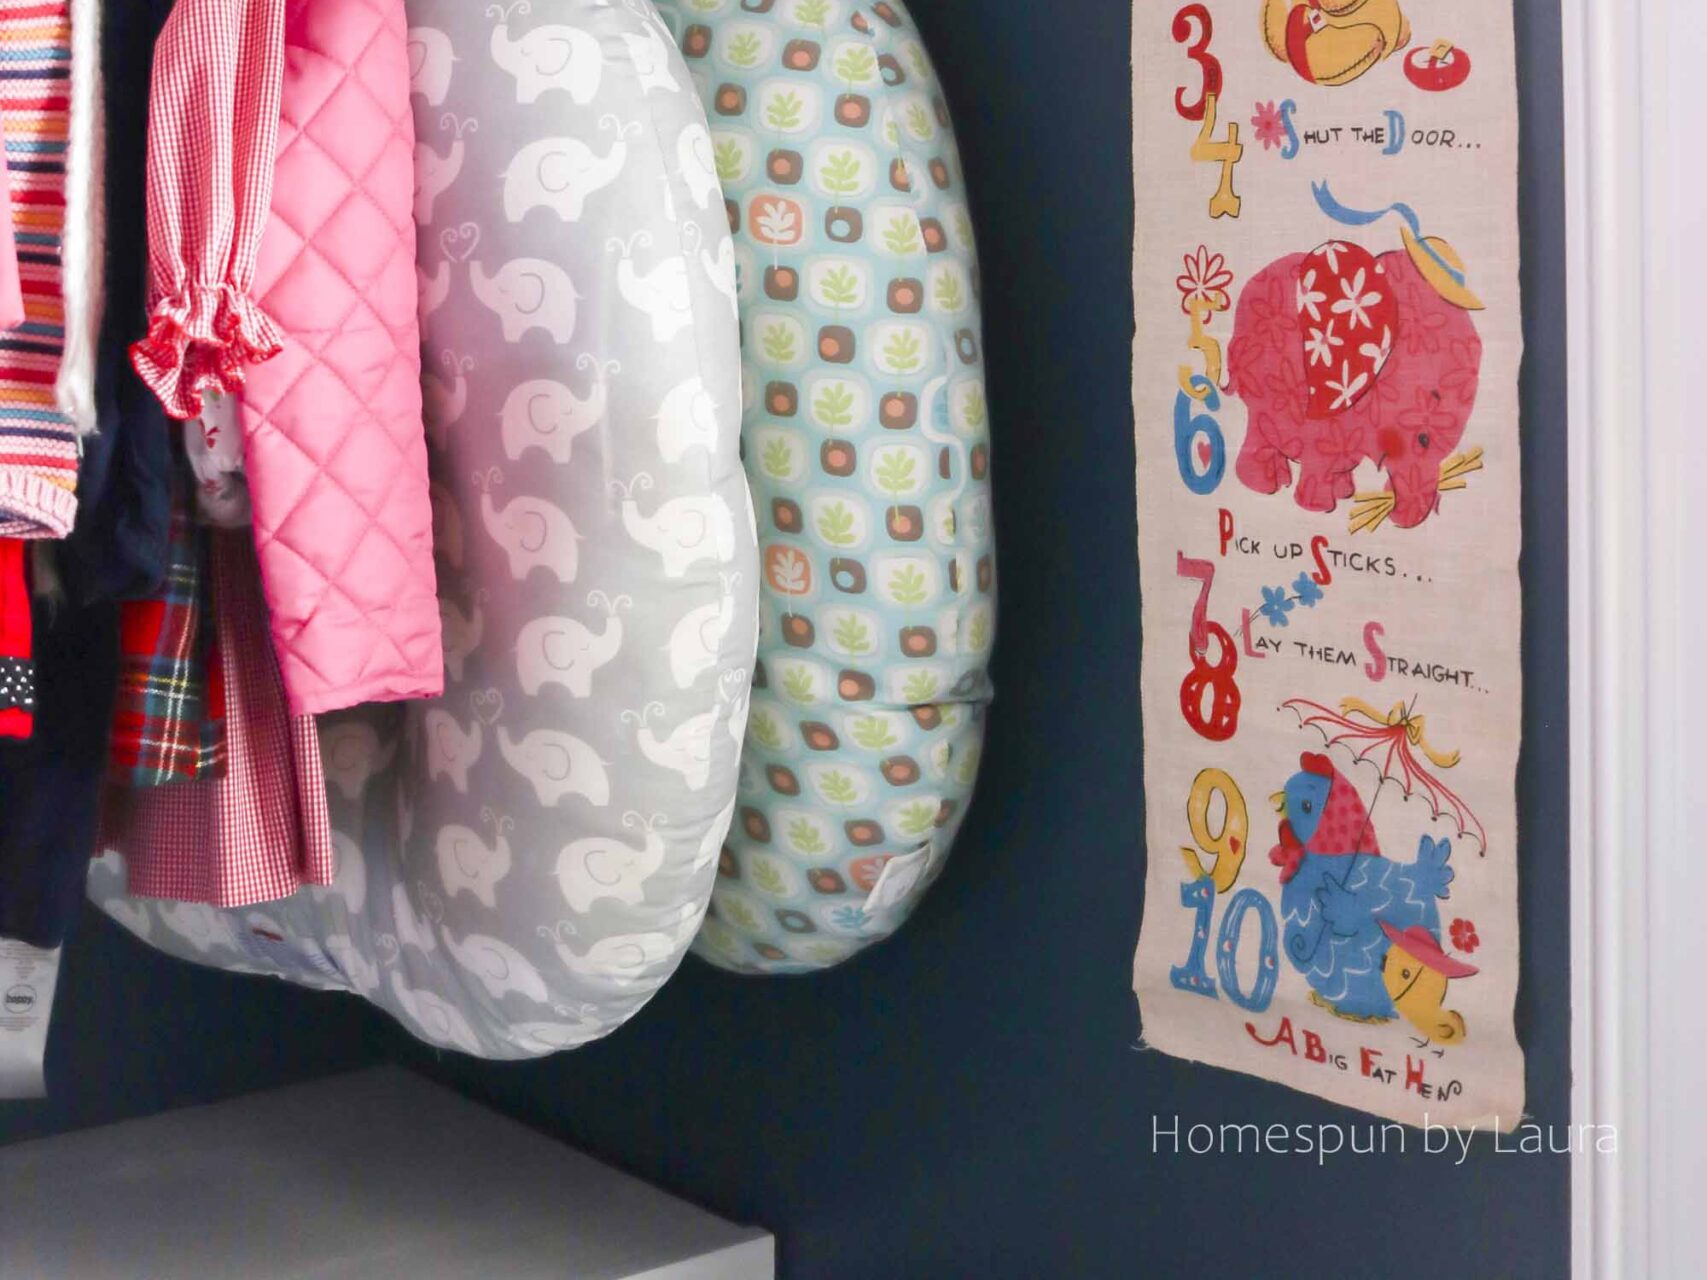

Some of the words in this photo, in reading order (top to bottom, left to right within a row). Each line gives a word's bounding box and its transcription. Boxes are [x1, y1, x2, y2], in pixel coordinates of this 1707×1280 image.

[1172, 3, 1222, 121] 3
[1190, 91, 1243, 218] 4
[1279, 99, 1343, 160] SHUT
[1351, 127, 1384, 144] THE
[1177, 287, 1221, 401] 5
[1174, 374, 1226, 495] 6
[1218, 508, 1260, 556] PICK
[1273, 543, 1304, 559] UP
[1177, 550, 1215, 651] 7
[1241, 608, 1282, 658] LAY
[1294, 642, 1356, 666] THEM
[1180, 620, 1241, 742] 8
[1180, 768, 1248, 893] 9
[1170, 875, 1279, 1013] 10
[1245, 1016, 1298, 1056] A
[1302, 1029, 1348, 1070] BIG
[1360, 1047, 1397, 1085] FAT
[1406, 1054, 1462, 1101] HEN
